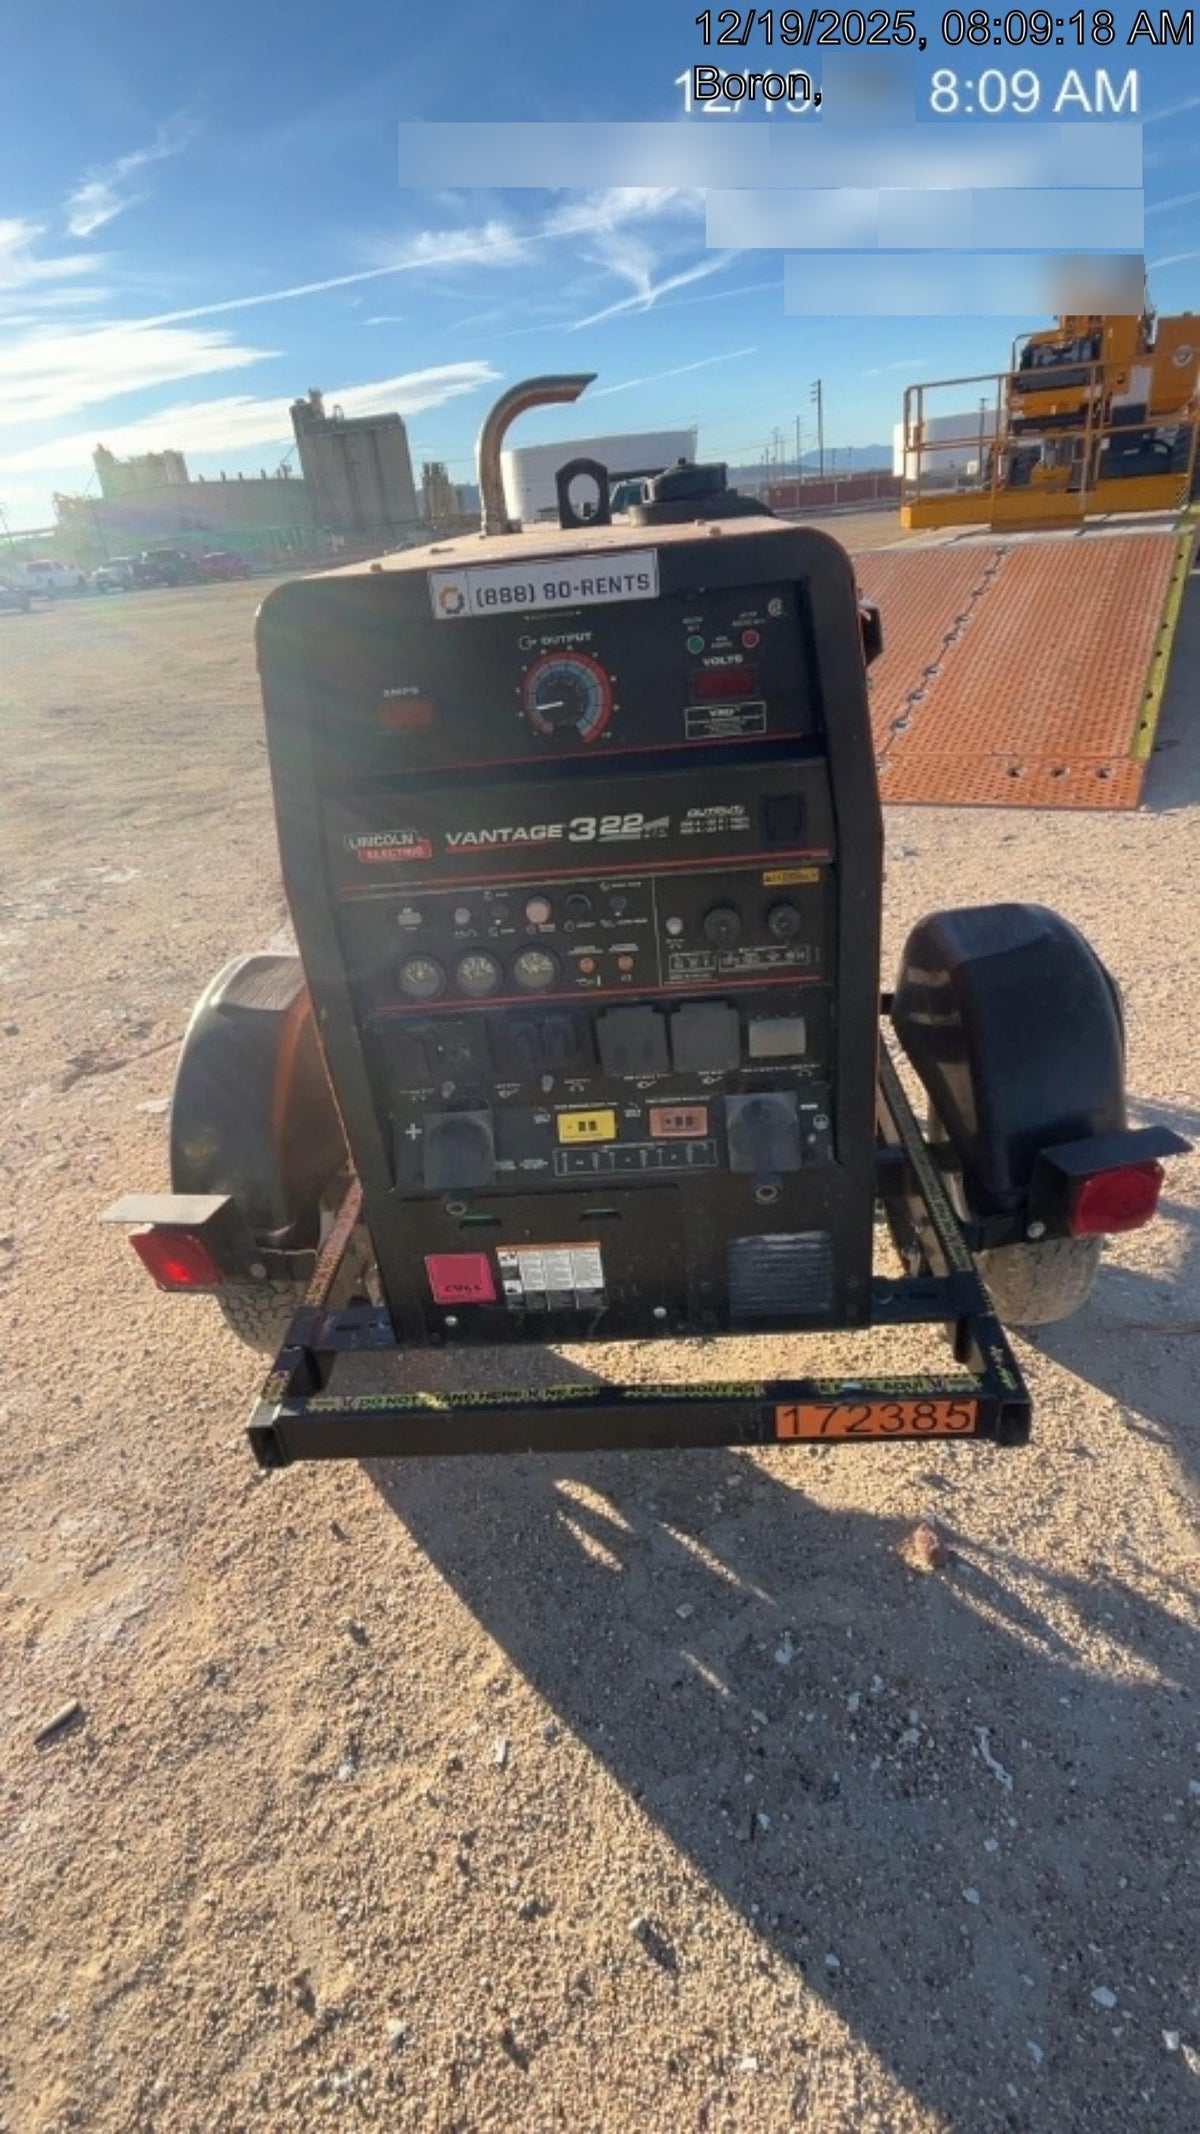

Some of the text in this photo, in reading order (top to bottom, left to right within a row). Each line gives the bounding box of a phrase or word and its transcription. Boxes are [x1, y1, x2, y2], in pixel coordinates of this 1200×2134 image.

[475, 573, 651, 608] (888) 80-RENTS
[540, 632, 592, 646] OUTPUT
[702, 653, 744, 667] VOLTS
[445, 824, 563, 846] VANTAGE
[568, 812, 643, 842] 322
[348, 831, 414, 850] LINCOLN
[366, 846, 425, 860] ELECTRIC
[783, 1402, 972, 1434] 172385
